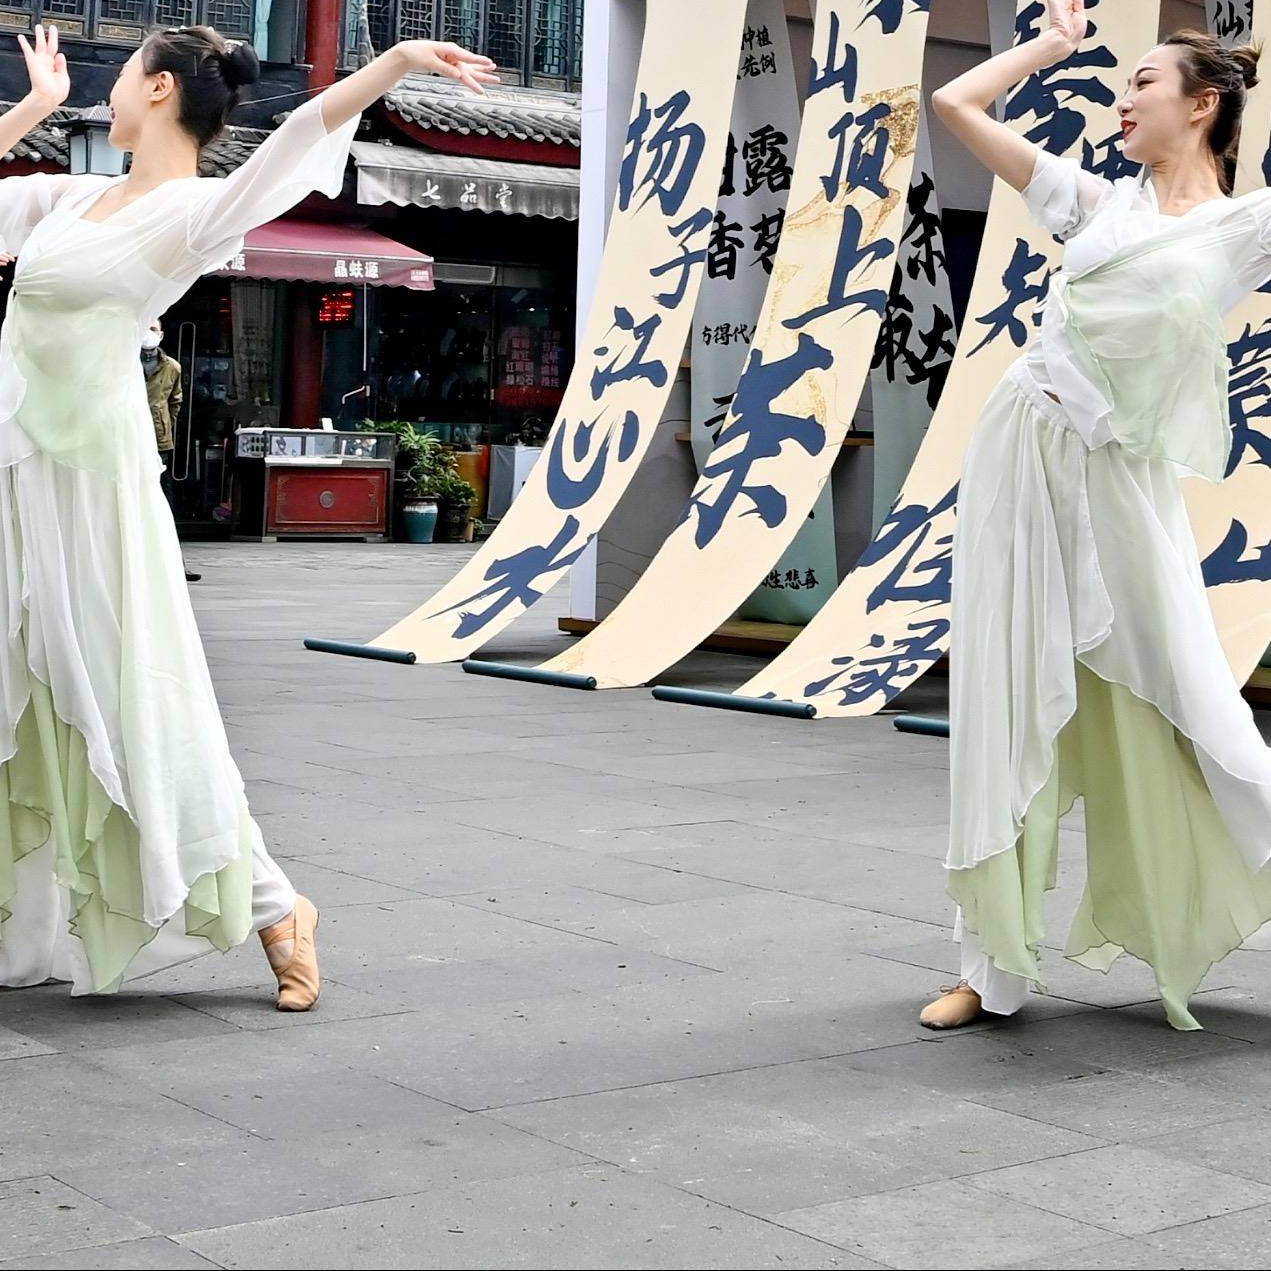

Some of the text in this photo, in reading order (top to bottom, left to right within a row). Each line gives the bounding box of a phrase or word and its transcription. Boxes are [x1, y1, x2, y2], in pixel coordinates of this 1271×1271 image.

[421, 178, 513, 209] 七品堂
[425, 89, 712, 639] 扬子江心水
